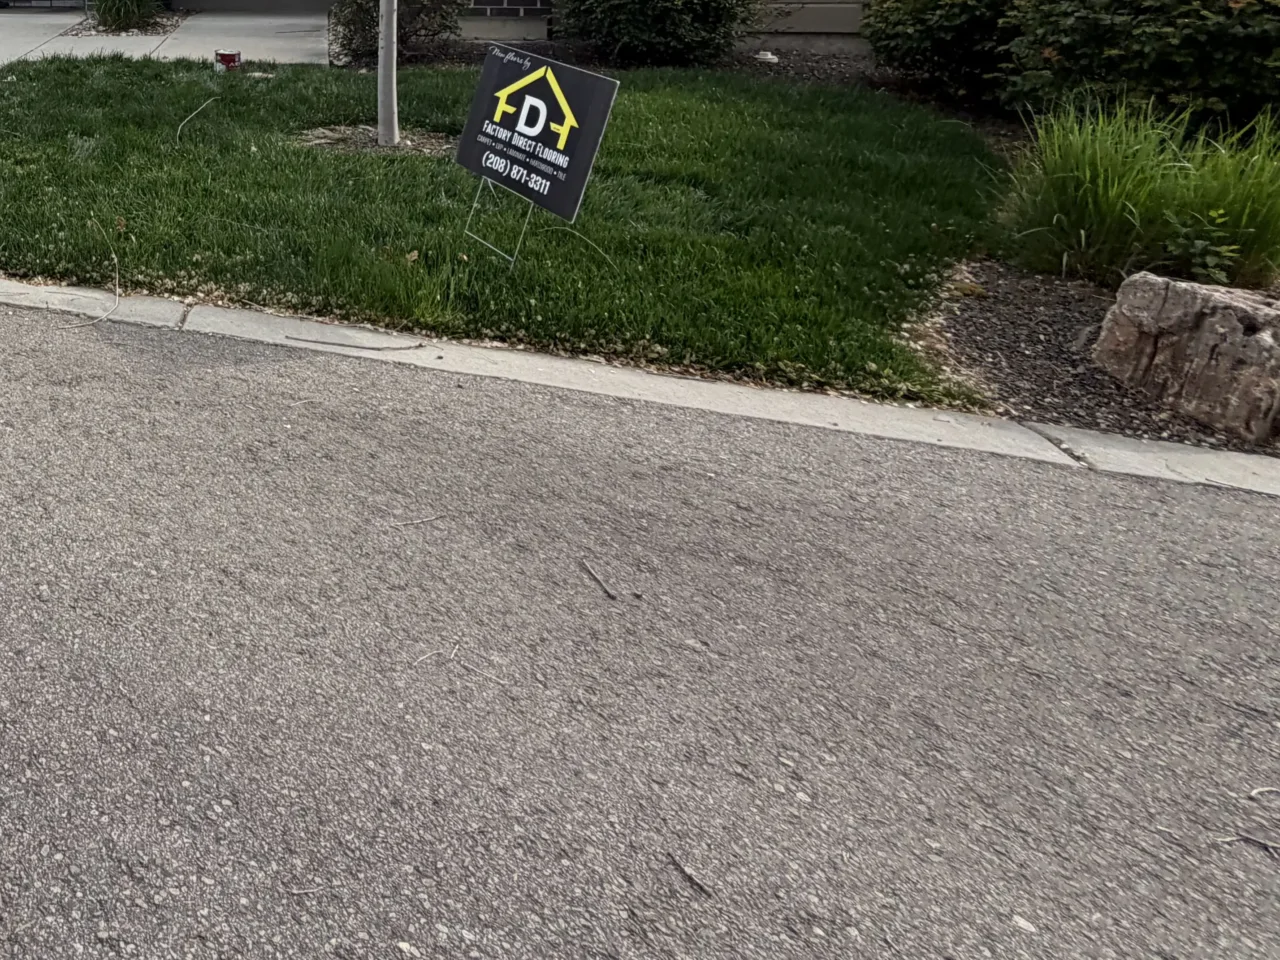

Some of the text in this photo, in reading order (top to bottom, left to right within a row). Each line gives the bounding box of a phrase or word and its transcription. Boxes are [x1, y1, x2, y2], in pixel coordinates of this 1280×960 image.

[482, 120, 570, 168] FACTORY DIRECT FLOORING
[482, 151, 551, 195] (208) 871-3311
